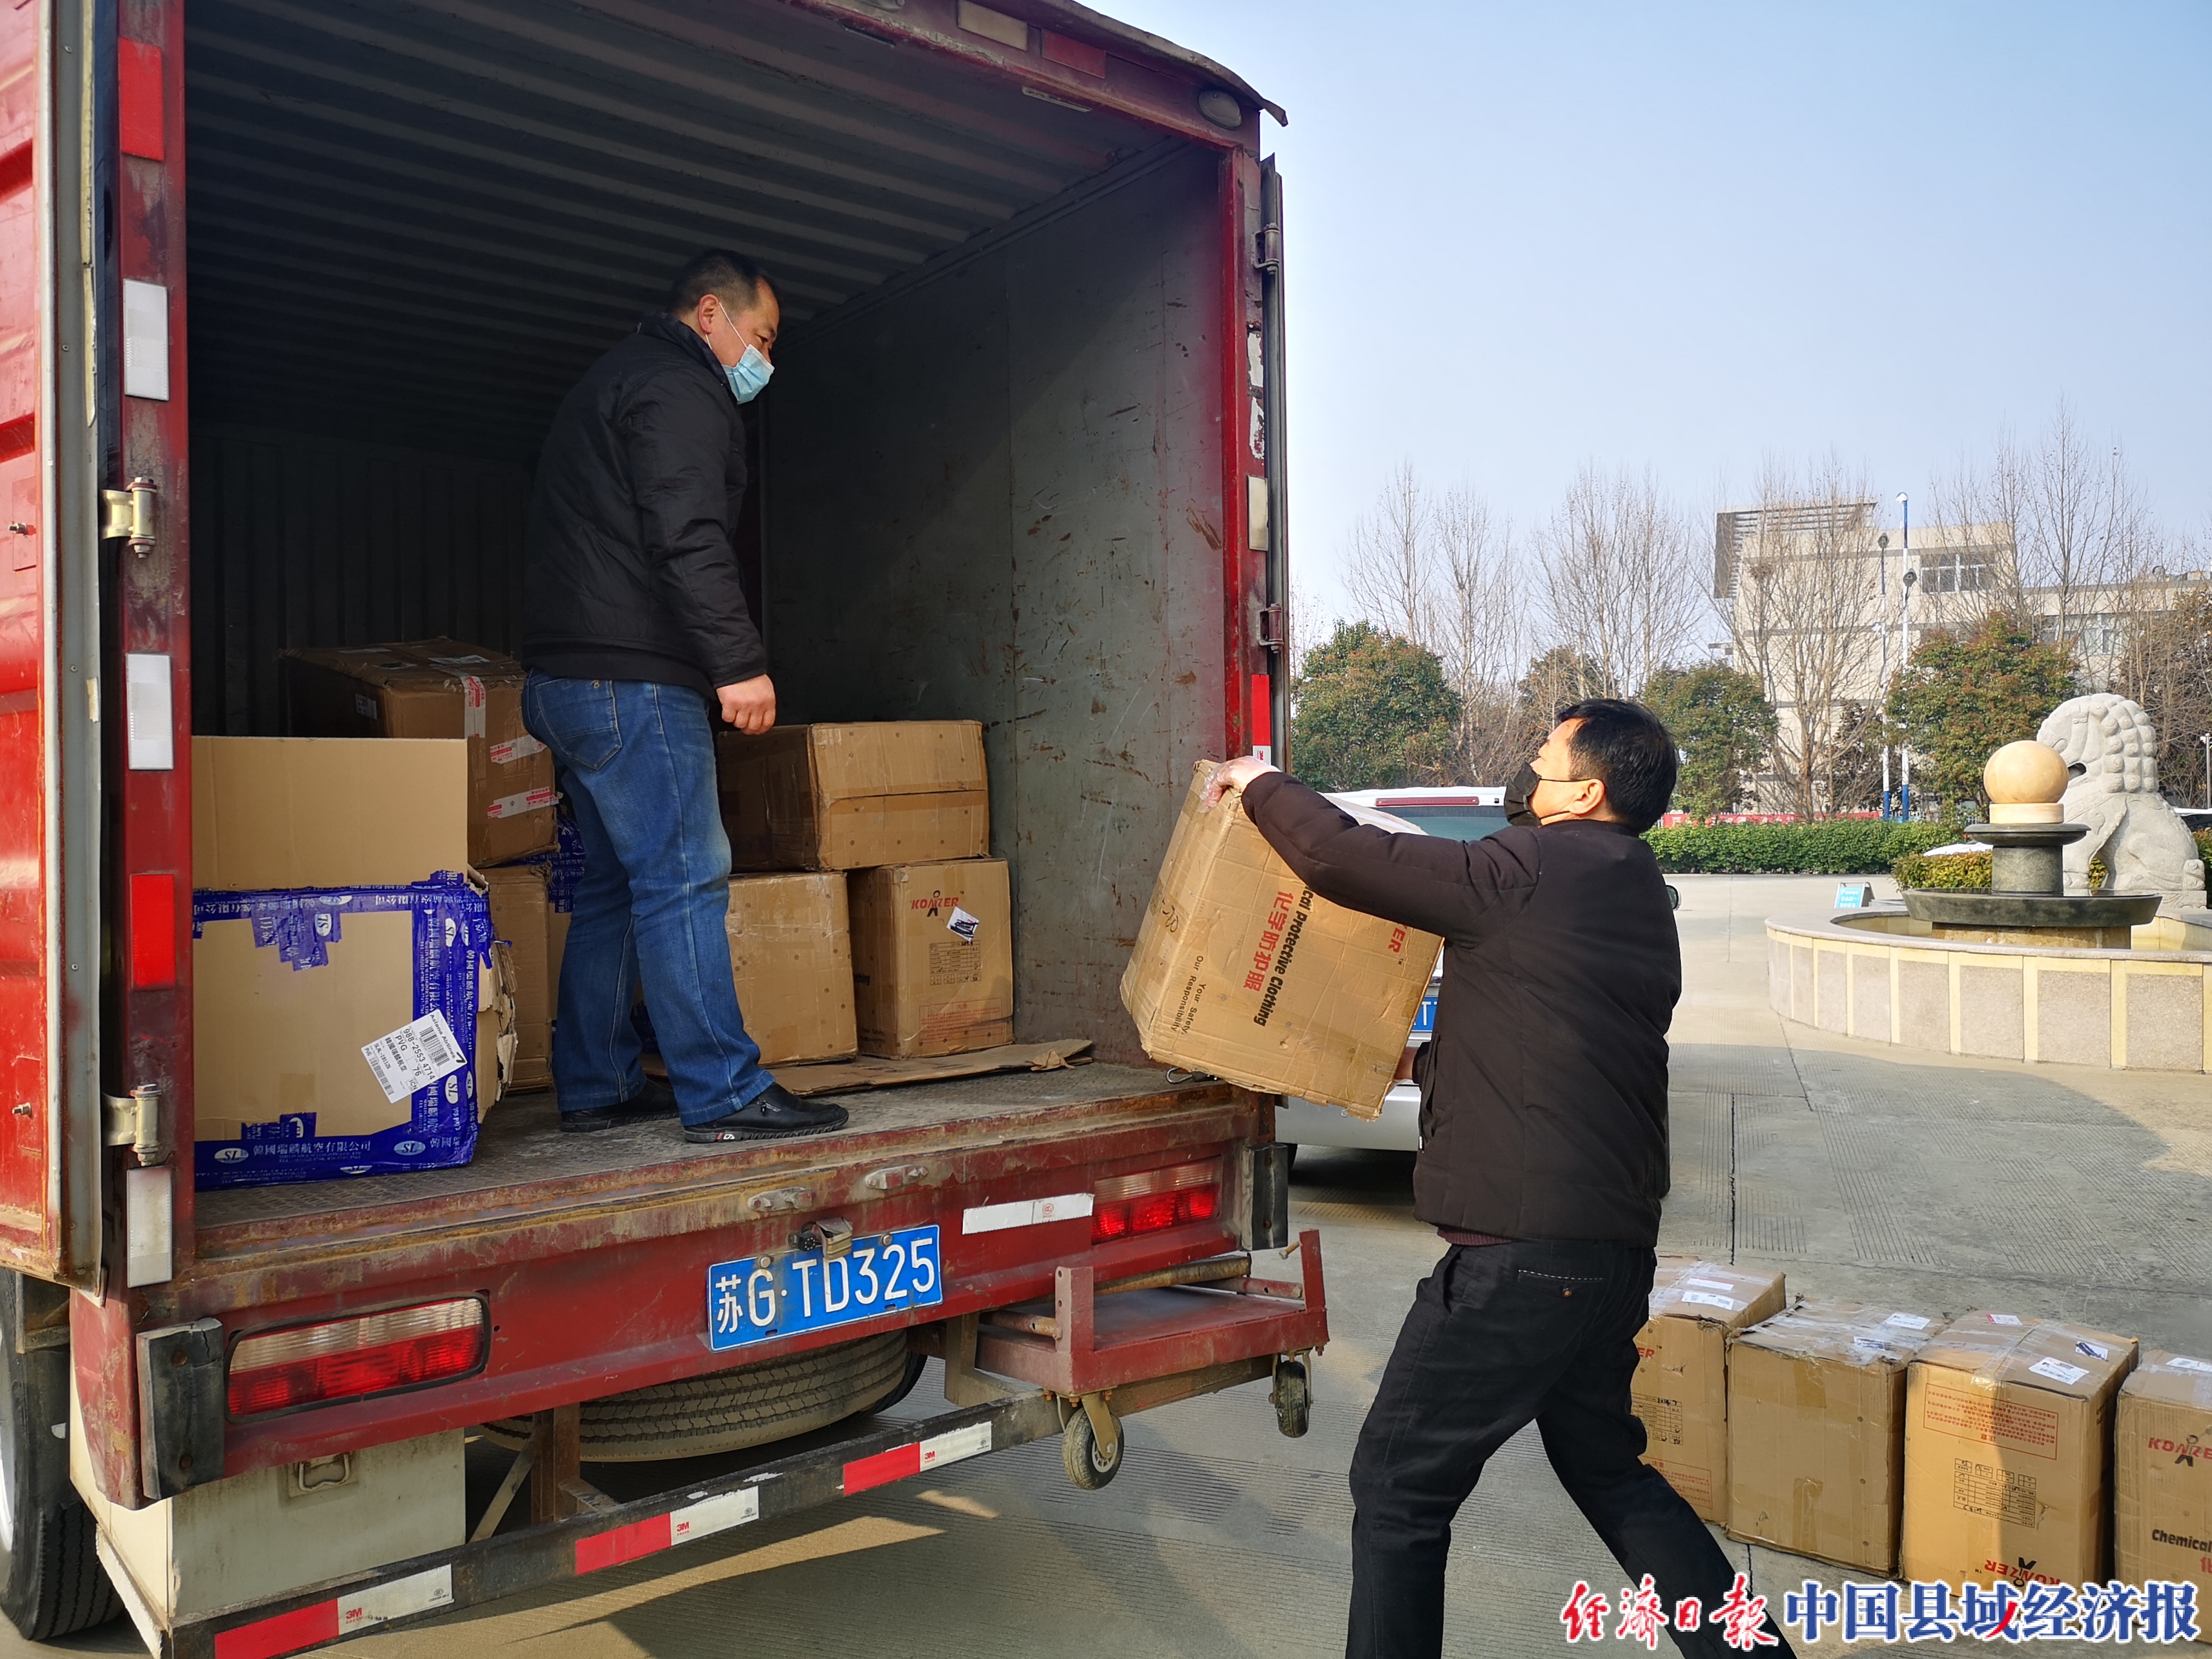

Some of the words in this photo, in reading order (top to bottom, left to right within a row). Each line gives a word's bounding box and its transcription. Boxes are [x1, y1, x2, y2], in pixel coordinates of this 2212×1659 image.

[1243, 890, 1295, 992] 化学防护服
[1275, 911, 1307, 976] Protective
[1193, 955, 1204, 971] Our
[1194, 984, 1207, 1004] Your
[1253, 974, 1284, 1027] Clothing
[1170, 975, 1197, 1032] Responsibility
[1180, 1007, 1198, 1035] Safety,
[395, 1035, 407, 1051] PVG
[403, 1028, 426, 1062] 988-2553
[423, 1063, 436, 1080] 4714
[412, 1067, 422, 1076] 76
[409, 1079, 418, 1090] ICN
[447, 1082, 458, 1097] SL
[223, 1150, 240, 1162] SL
[924, 1450, 935, 1460] 3M
[676, 1521, 689, 1532] 3M
[2152, 1529, 2212, 1553] Chemical
[346, 1607, 363, 1620] 3M
